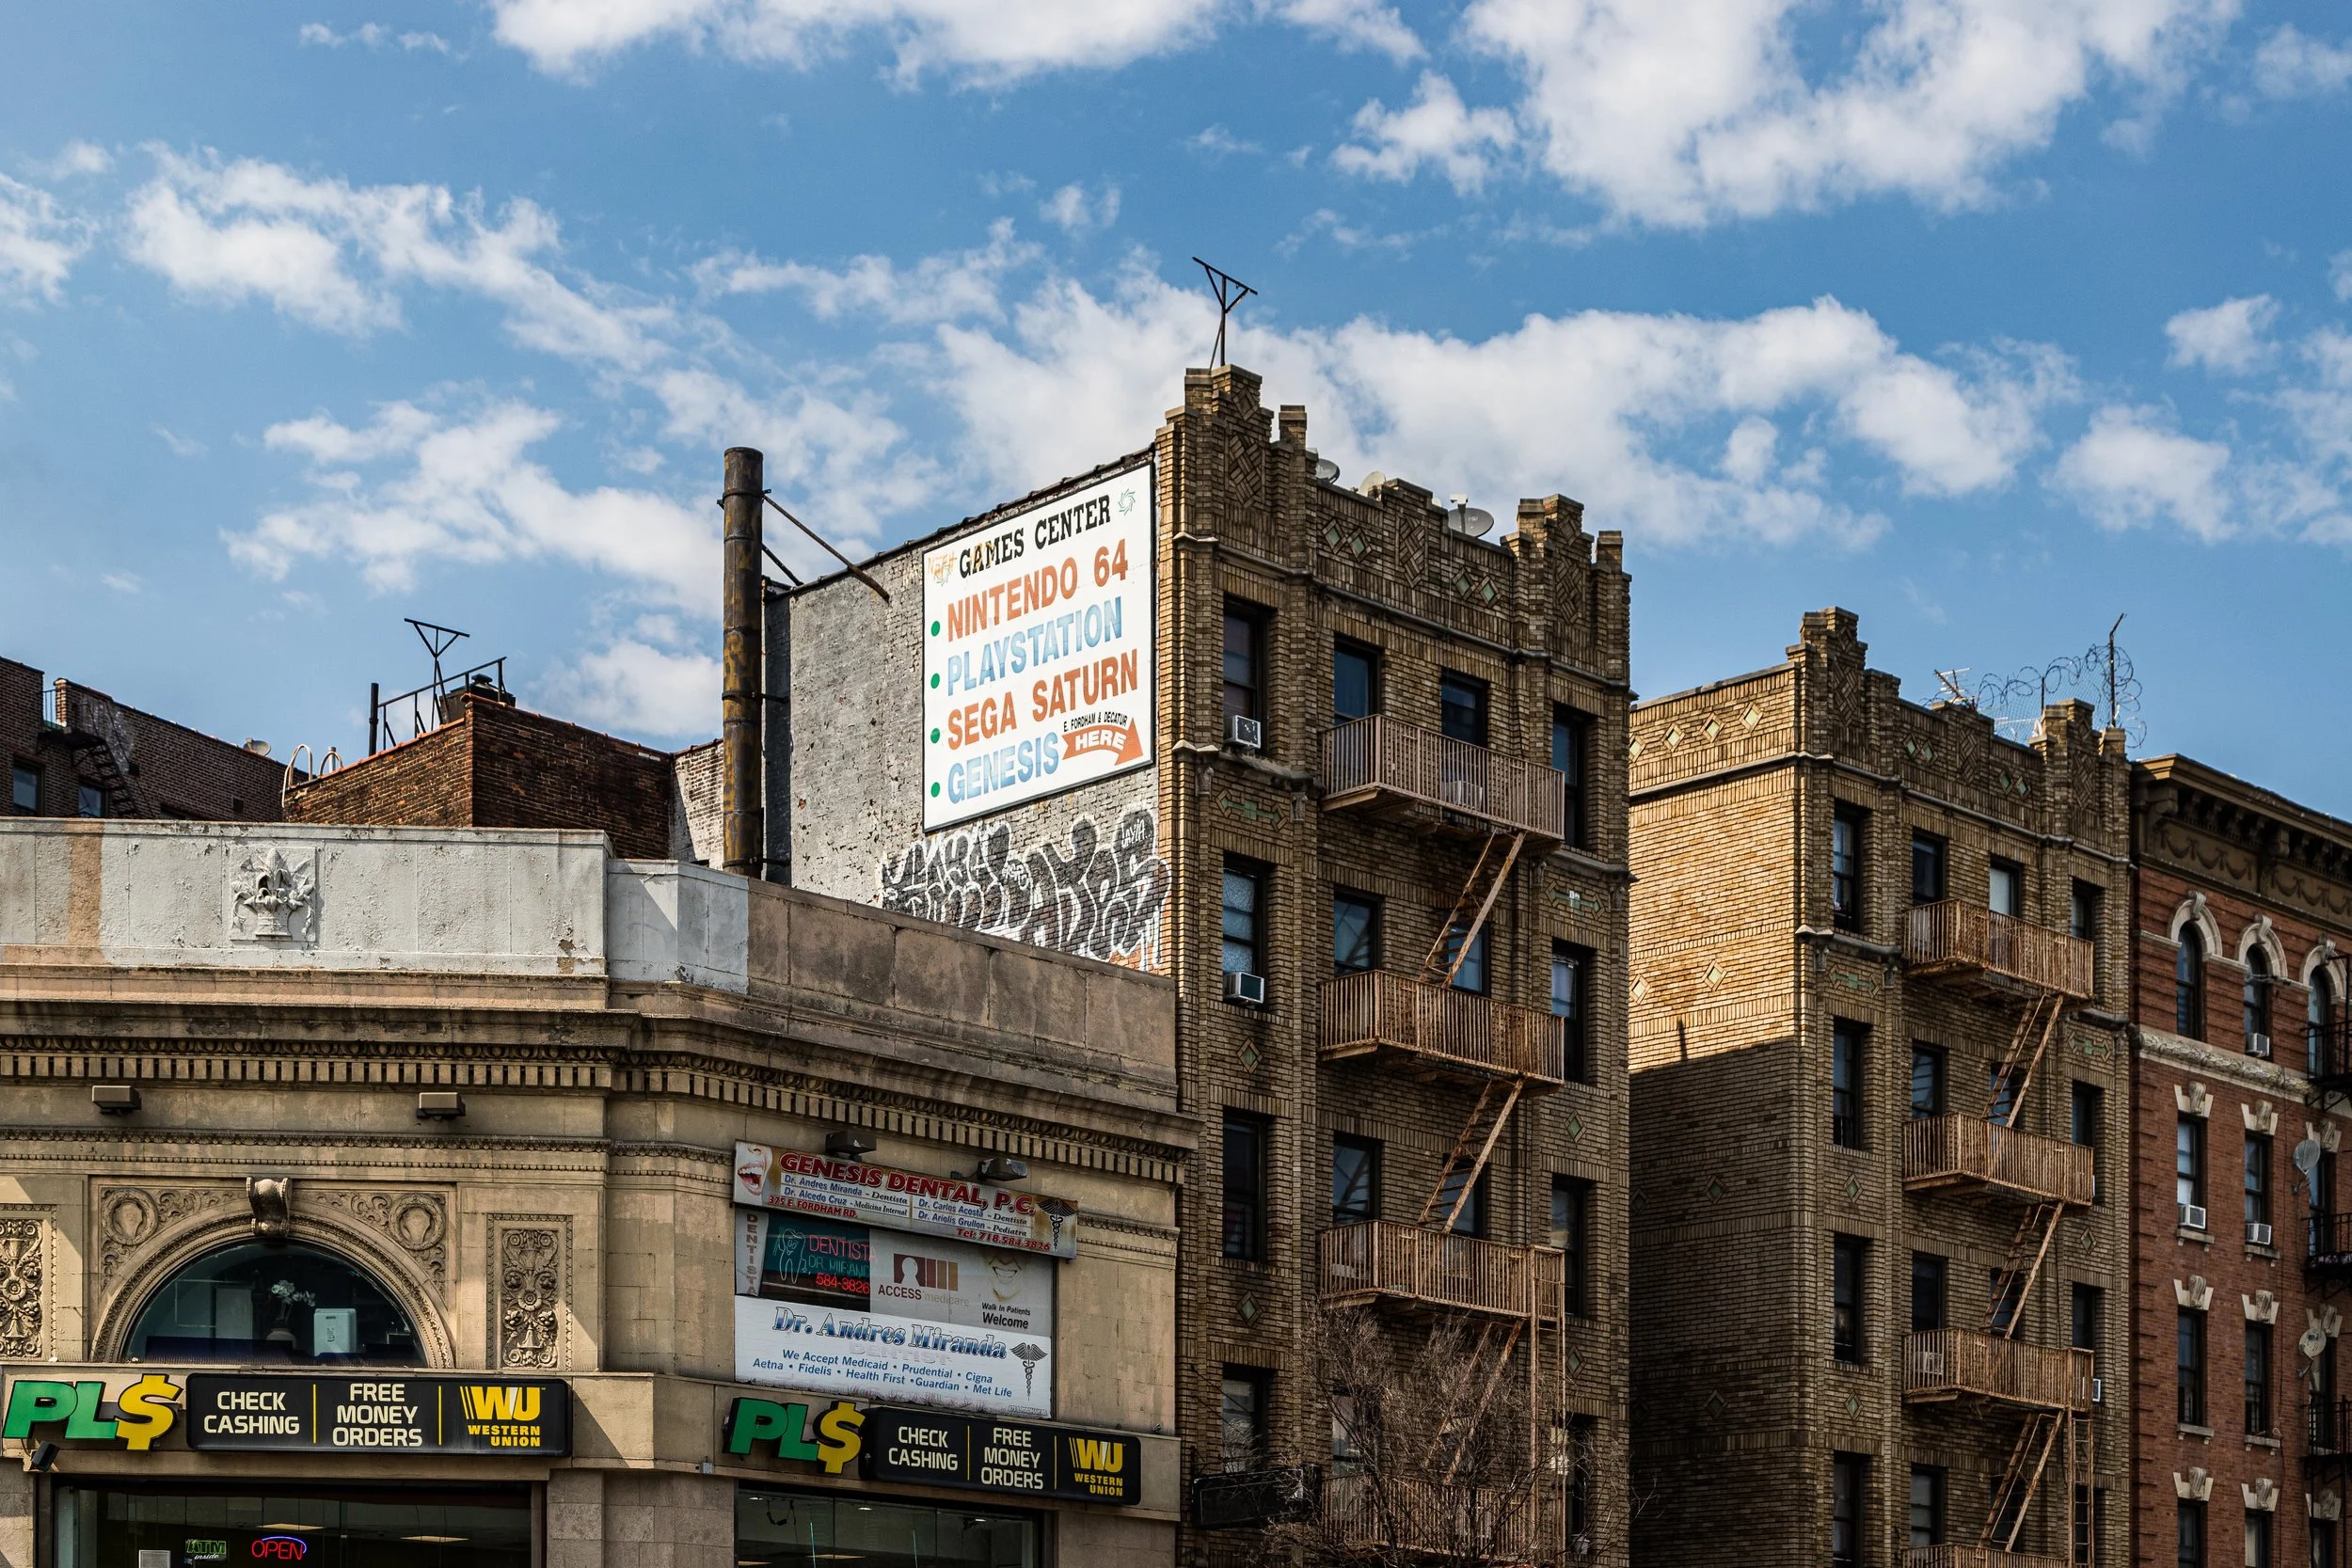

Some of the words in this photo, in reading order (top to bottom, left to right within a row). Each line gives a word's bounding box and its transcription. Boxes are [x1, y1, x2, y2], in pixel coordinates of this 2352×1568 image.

[960, 528, 1025, 578] GAMES
[1035, 495, 1111, 549] CENTER
[947, 557, 1078, 642] NINTENDO
[1094, 539, 1128, 587] 64
[947, 596, 1122, 696] PLAYSTATION
[947, 691, 1017, 751] SEGA
[1032, 648, 1137, 722] SATURN
[1063, 721, 1069, 732] E.
[1071, 712, 1096, 730] FORDHAM
[1098, 712, 1102, 722] &
[1104, 711, 1128, 727] DECATUR
[1074, 729, 1127, 751] HERE
[947, 732, 1059, 804] GENESIS
[780, 1152, 883, 1188] GENESIS
[887, 1171, 988, 1211] DENTAL,
[993, 1190, 1037, 1215] P.C.
[784, 1174, 796, 1184] Dr.
[800, 1177, 827, 1190] Andres
[830, 1182, 863, 1196] Miranda
[871, 1191, 908, 1204] Dentista
[769, 1196, 786, 1206] 375
[797, 1201, 841, 1216] FORDHAM
[784, 1186, 796, 1197] Dr.
[799, 1189, 827, 1203] Alcedo
[829, 1195, 848, 1206] Cruz
[853, 1200, 882, 1212] Medicina
[882, 1206, 908, 1216] Internal
[918, 1198, 930, 1209] Dr.
[932, 1201, 957, 1213] Carlos
[958, 1205, 984, 1217] Acosta
[993, 1212, 1027, 1226] Dentista
[917, 1211, 930, 1221] Dr.
[958, 1217, 985, 1229] Grullon
[993, 1225, 1027, 1237] Pediatra
[956, 1227, 977, 1240] Tel:
[978, 1231, 1051, 1251] 718.584.3826
[746, 1213, 758, 1295] DENTISTA
[816, 1272, 870, 1295] 584-3826
[878, 1284, 922, 1301] ACCESS
[924, 1291, 970, 1307] medicare
[981, 1302, 997, 1311] Walk
[999, 1304, 1006, 1312] In
[1007, 1306, 1031, 1316] Patients
[982, 1312, 1029, 1329] Welcome
[772, 1307, 813, 1334] Dr.
[816, 1312, 907, 1346] Andres
[908, 1324, 1008, 1360] Miranda
[753, 1358, 784, 1370] Aetna
[798, 1363, 832, 1376] Fidelis
[846, 1369, 880, 1381] Health
[883, 1373, 906, 1385] First
[915, 1377, 960, 1391] Guardian
[973, 1385, 992, 1395] Met
[994, 1386, 1012, 1398] Life
[783, 1349, 800, 1360] We
[803, 1352, 838, 1365] Accept
[842, 1356, 888, 1370] Medicaid
[901, 1363, 953, 1379] Prudential
[965, 1371, 993, 1385] Cigna
[216, 1391, 286, 1411] CHECK
[349, 1383, 405, 1402] FREE
[469, 1386, 541, 1421] WU
[2, 1373, 184, 1450] PL$
[336, 1404, 419, 1425] MONEY
[203, 1415, 300, 1435] CASHING
[468, 1425, 541, 1435] WESTERN
[724, 1397, 866, 1474] PL$
[332, 1427, 423, 1447] ORDERS
[490, 1436, 541, 1447] UNION
[898, 1426, 948, 1449] CHECK
[993, 1427, 1032, 1448] FREE
[888, 1447, 959, 1471] CASHING
[984, 1447, 1041, 1469] MONEY
[1075, 1438, 1123, 1473] WU
[980, 1466, 1043, 1490] ORDERS
[1074, 1472, 1123, 1486] WESTERN
[1089, 1484, 1123, 1497] UNION
[186, 1540, 227, 1554] ATM
[251, 1540, 303, 1560] OPEN
